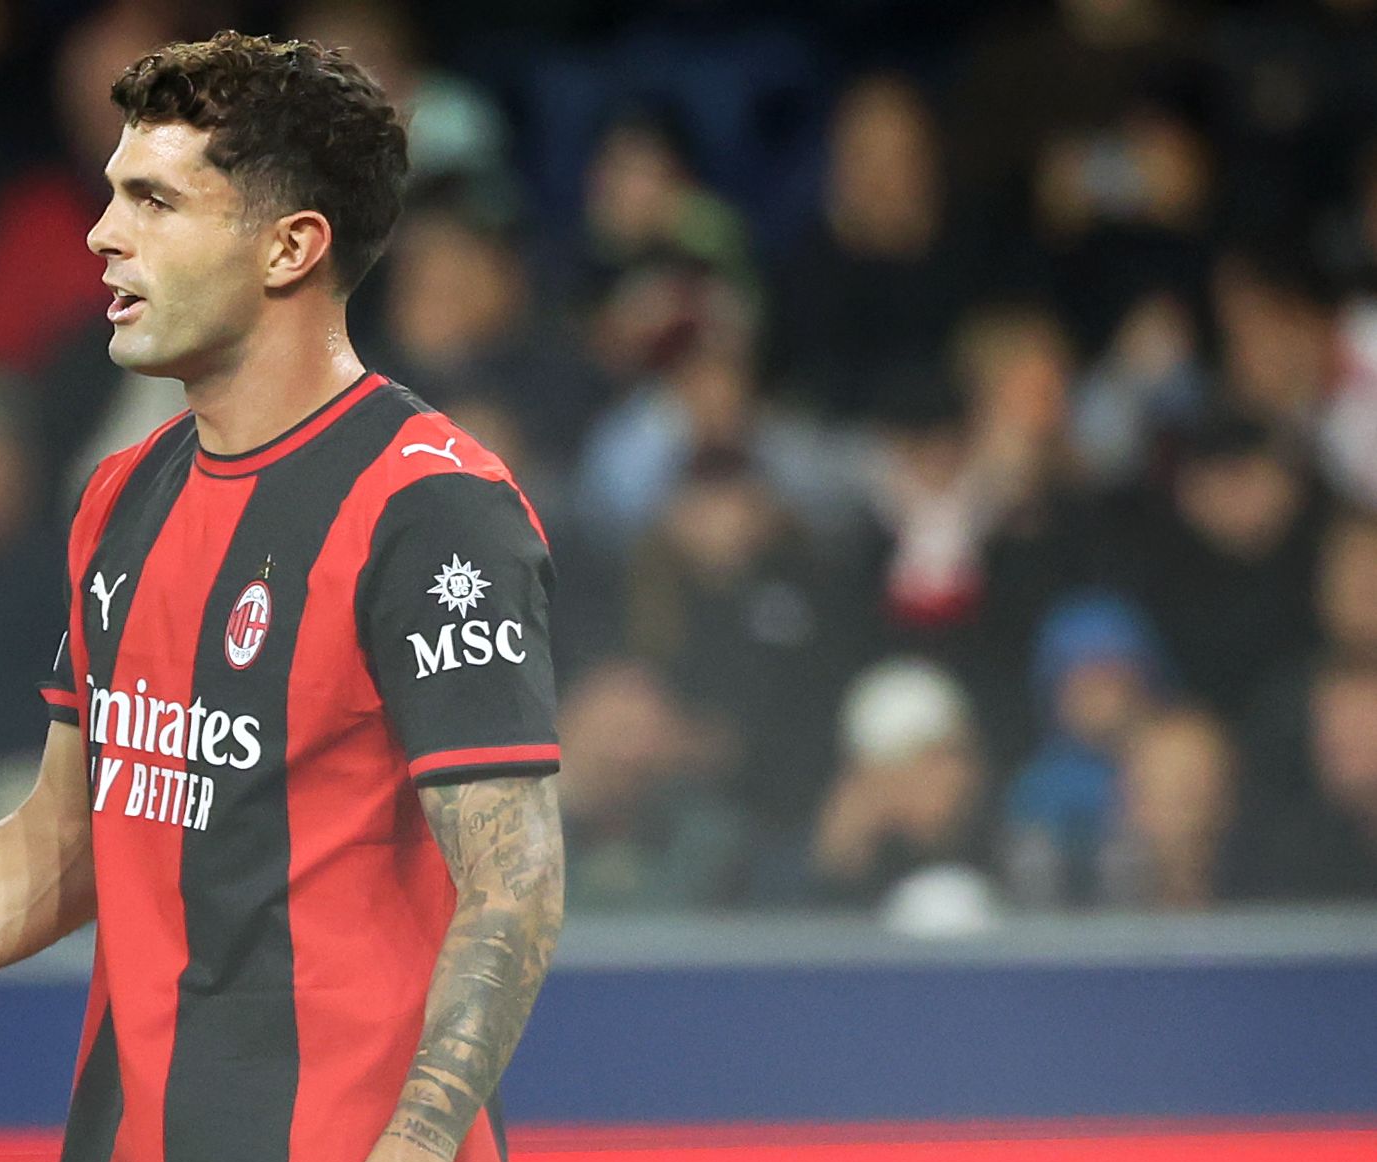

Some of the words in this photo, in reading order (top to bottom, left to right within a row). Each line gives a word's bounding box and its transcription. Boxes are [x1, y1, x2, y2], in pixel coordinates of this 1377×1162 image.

[406, 620, 526, 679] MSC
[86, 674, 262, 770] mirates
[124, 762, 214, 831] BETTER
